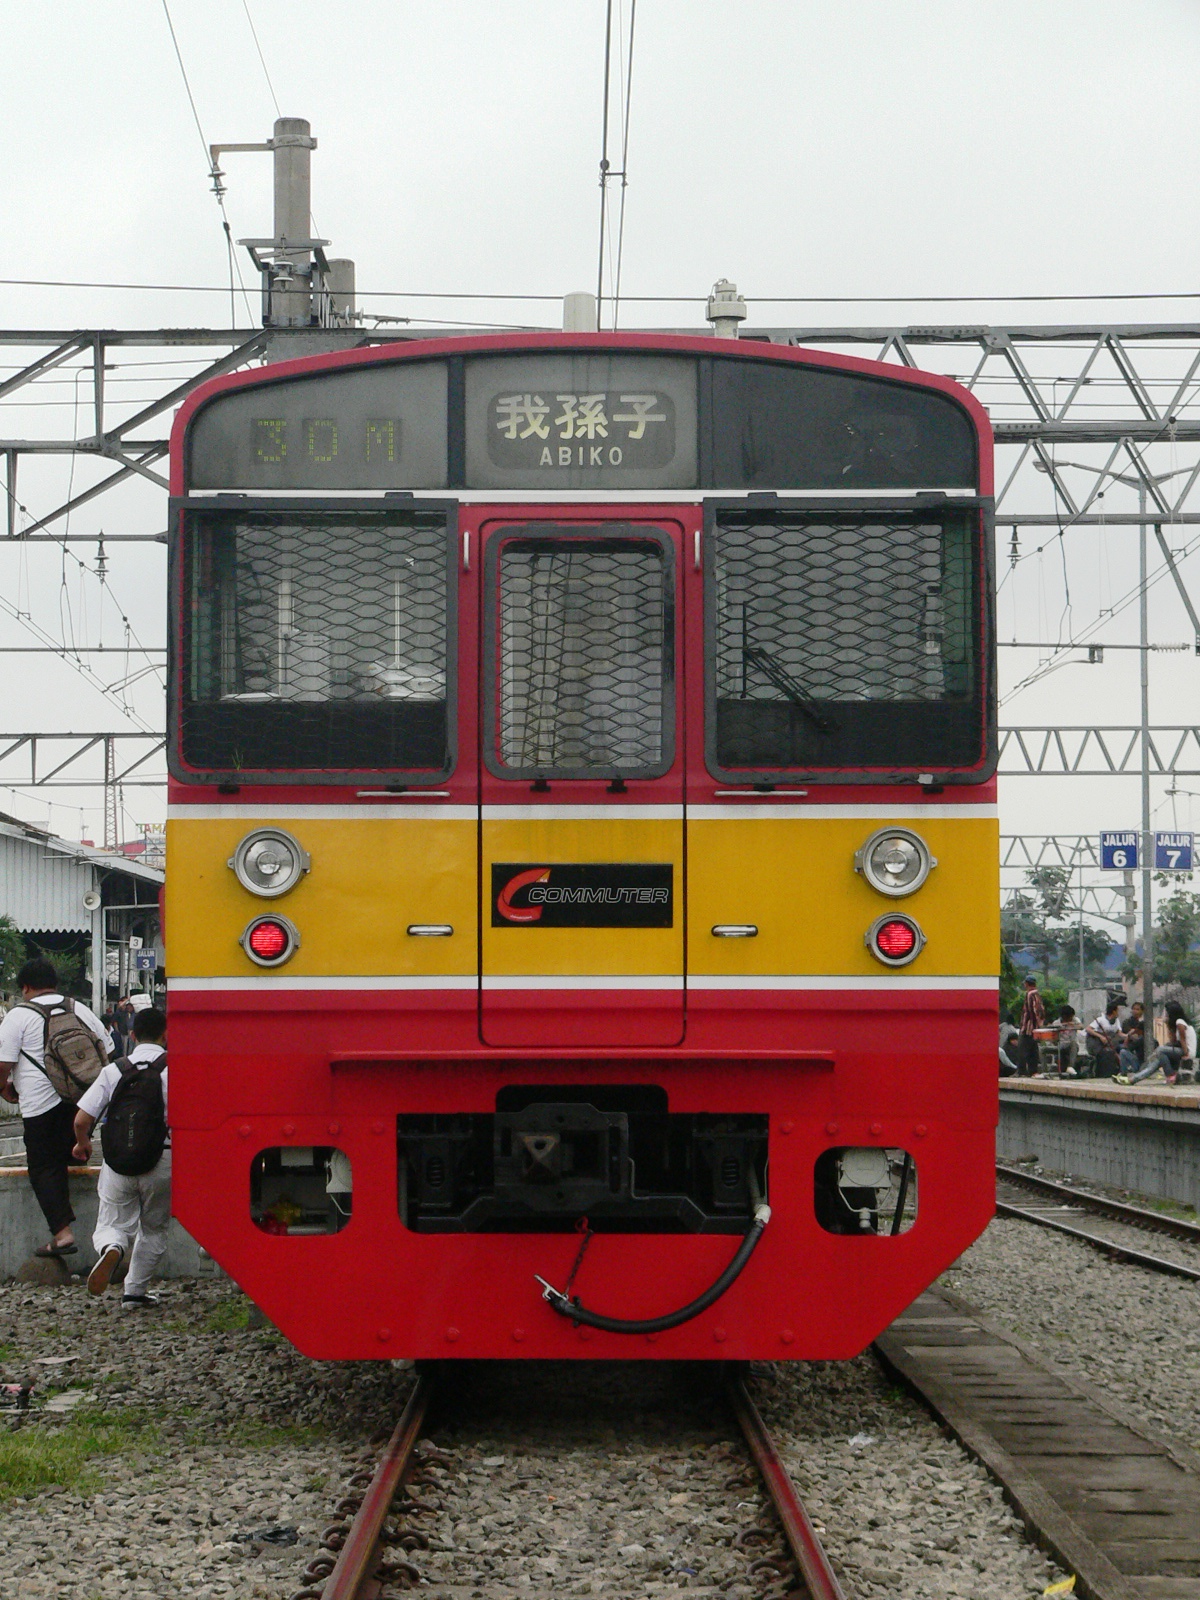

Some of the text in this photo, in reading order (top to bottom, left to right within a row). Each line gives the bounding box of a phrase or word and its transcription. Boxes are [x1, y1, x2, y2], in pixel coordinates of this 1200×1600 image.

[496, 394, 667, 440] 我孫子
[539, 446, 623, 466] ABIKO
[1103, 834, 1136, 846] JALUR
[1157, 834, 1191, 847] JALUR
[1112, 850, 1127, 867] 6
[1166, 850, 1182, 868] 7
[528, 887, 669, 904] COMMUTER
[132, 938, 140, 947] 3
[142, 959, 150, 968] 3
